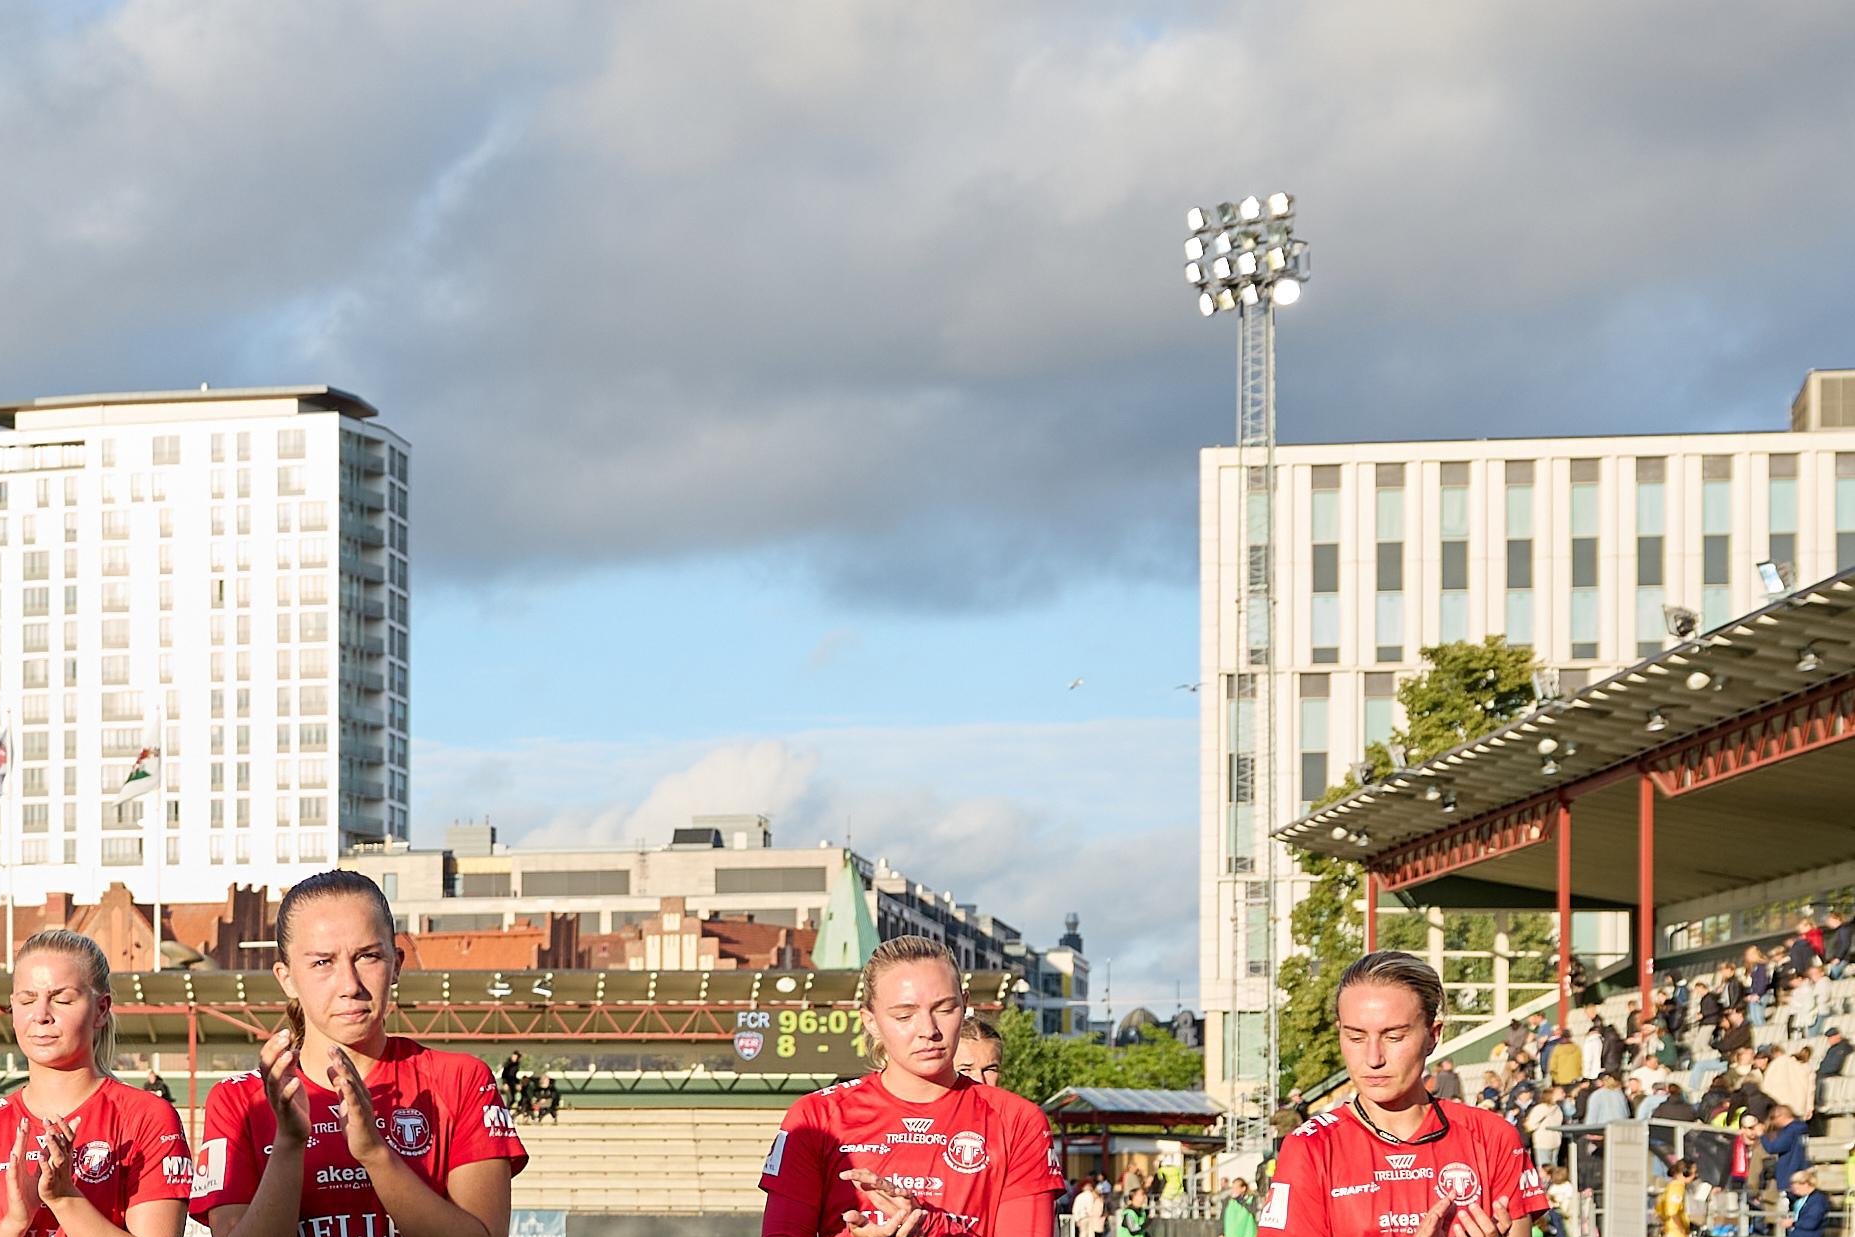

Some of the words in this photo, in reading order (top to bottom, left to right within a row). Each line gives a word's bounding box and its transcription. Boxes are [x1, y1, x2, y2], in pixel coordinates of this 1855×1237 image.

[737, 1012, 770, 1028] FCR
[778, 1010, 862, 1033] 96:07
[776, 1035, 795, 1057] 8
[886, 1132, 948, 1146] TRELLEBORG
[839, 1144, 880, 1154] CRAFT
[316, 1165, 367, 1184] akea
[1374, 1167, 1434, 1182] TRELLEBORG
[1330, 1184, 1371, 1198] CRAFT
[1379, 1210, 1420, 1228] akea
